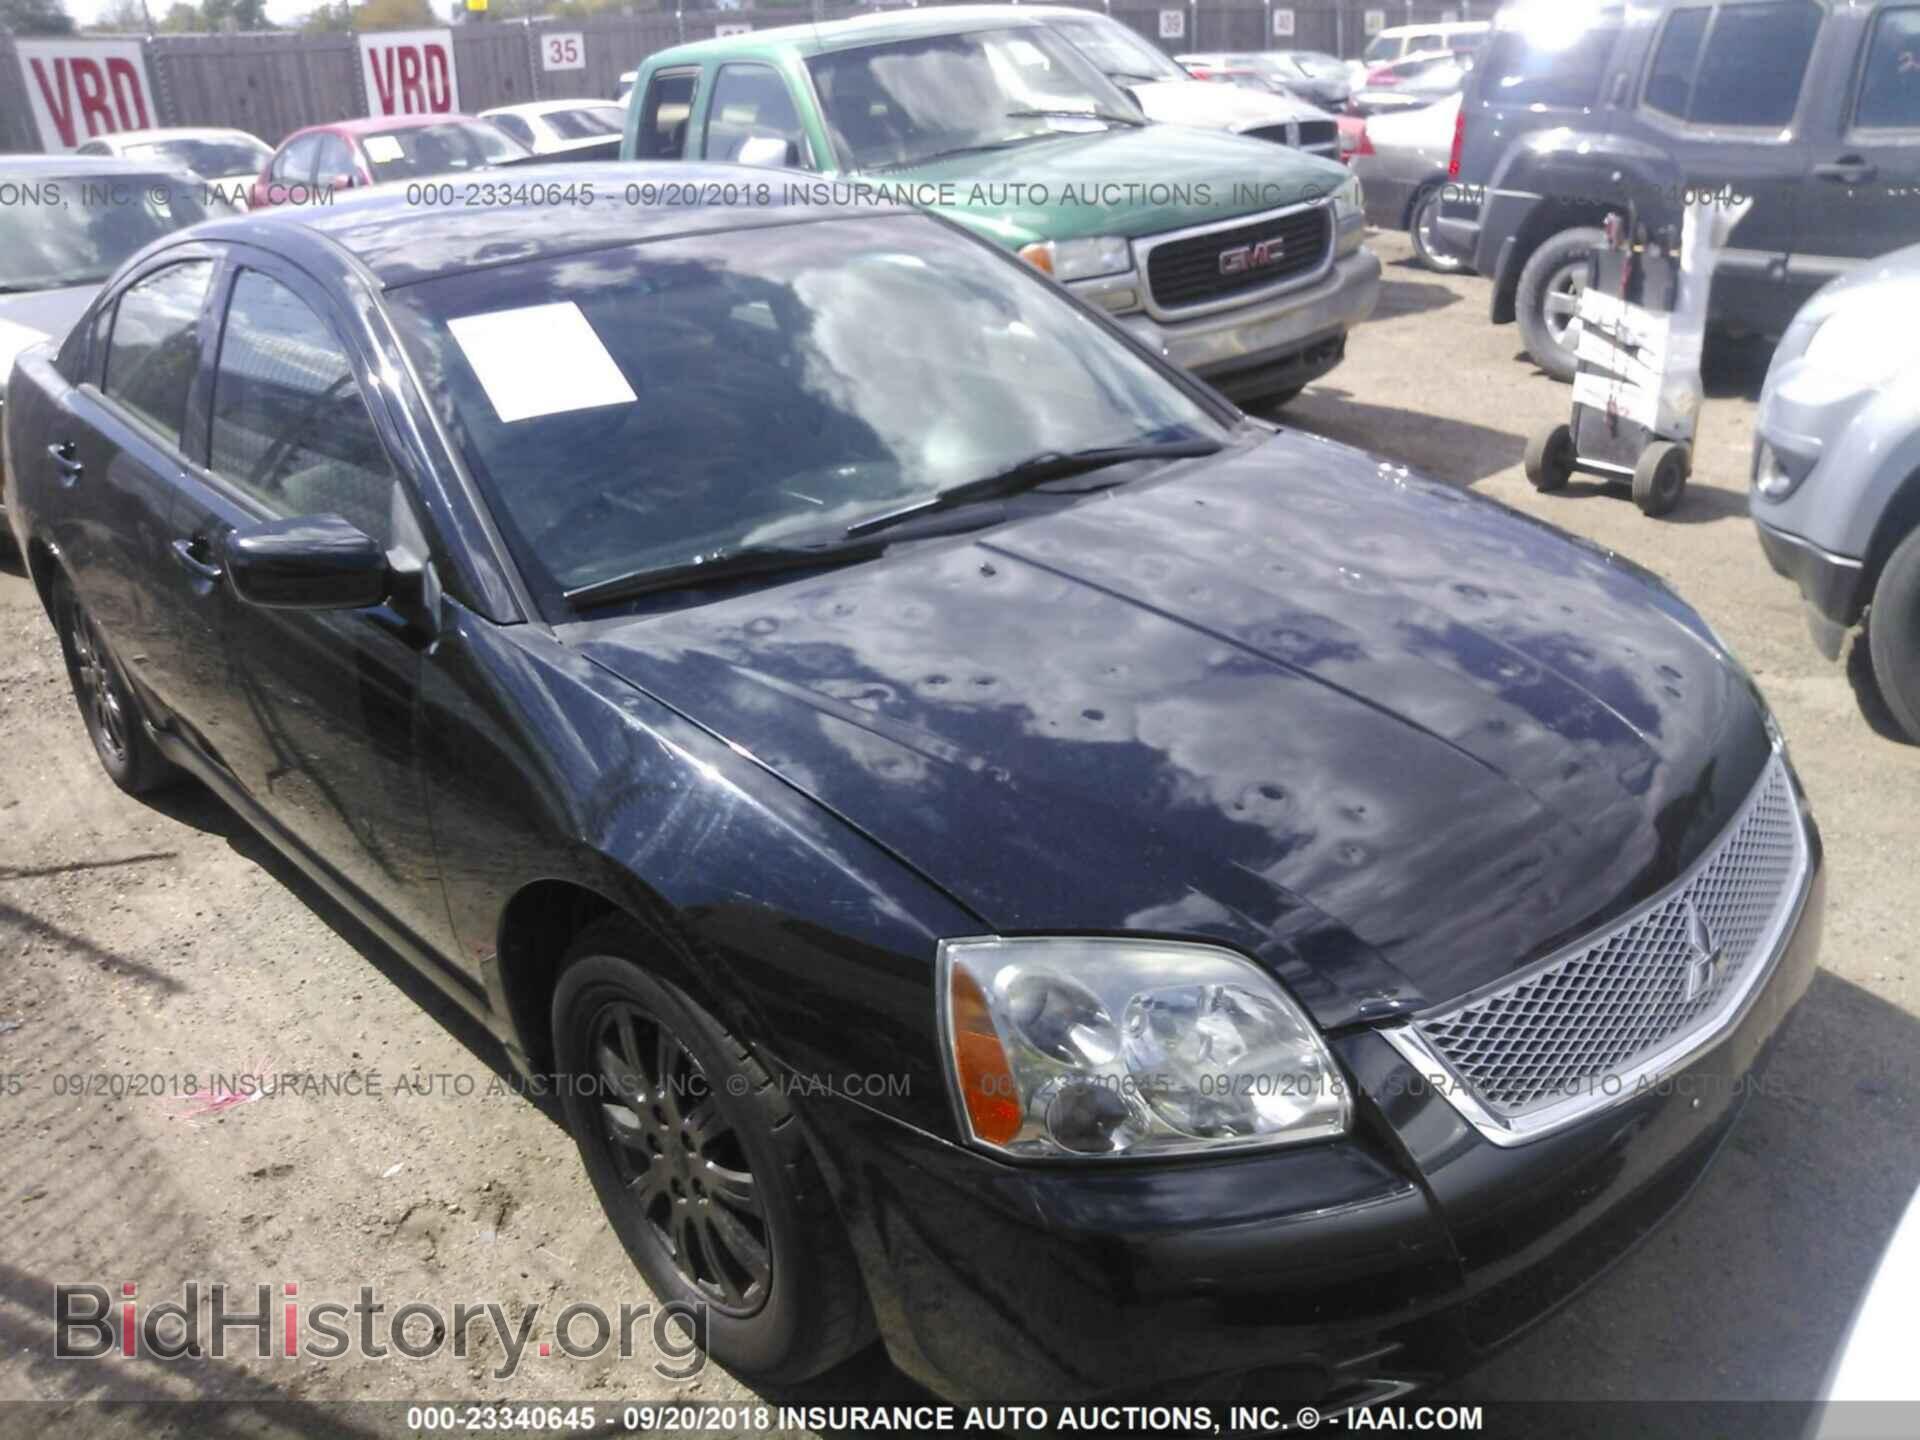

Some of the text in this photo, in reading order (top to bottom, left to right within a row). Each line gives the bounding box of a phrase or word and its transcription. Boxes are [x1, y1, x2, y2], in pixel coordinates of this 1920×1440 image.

[550, 39, 577, 64] 35
[30, 57, 151, 147] VRD
[368, 44, 452, 116] VRD
[1219, 238, 1283, 275] GMC
